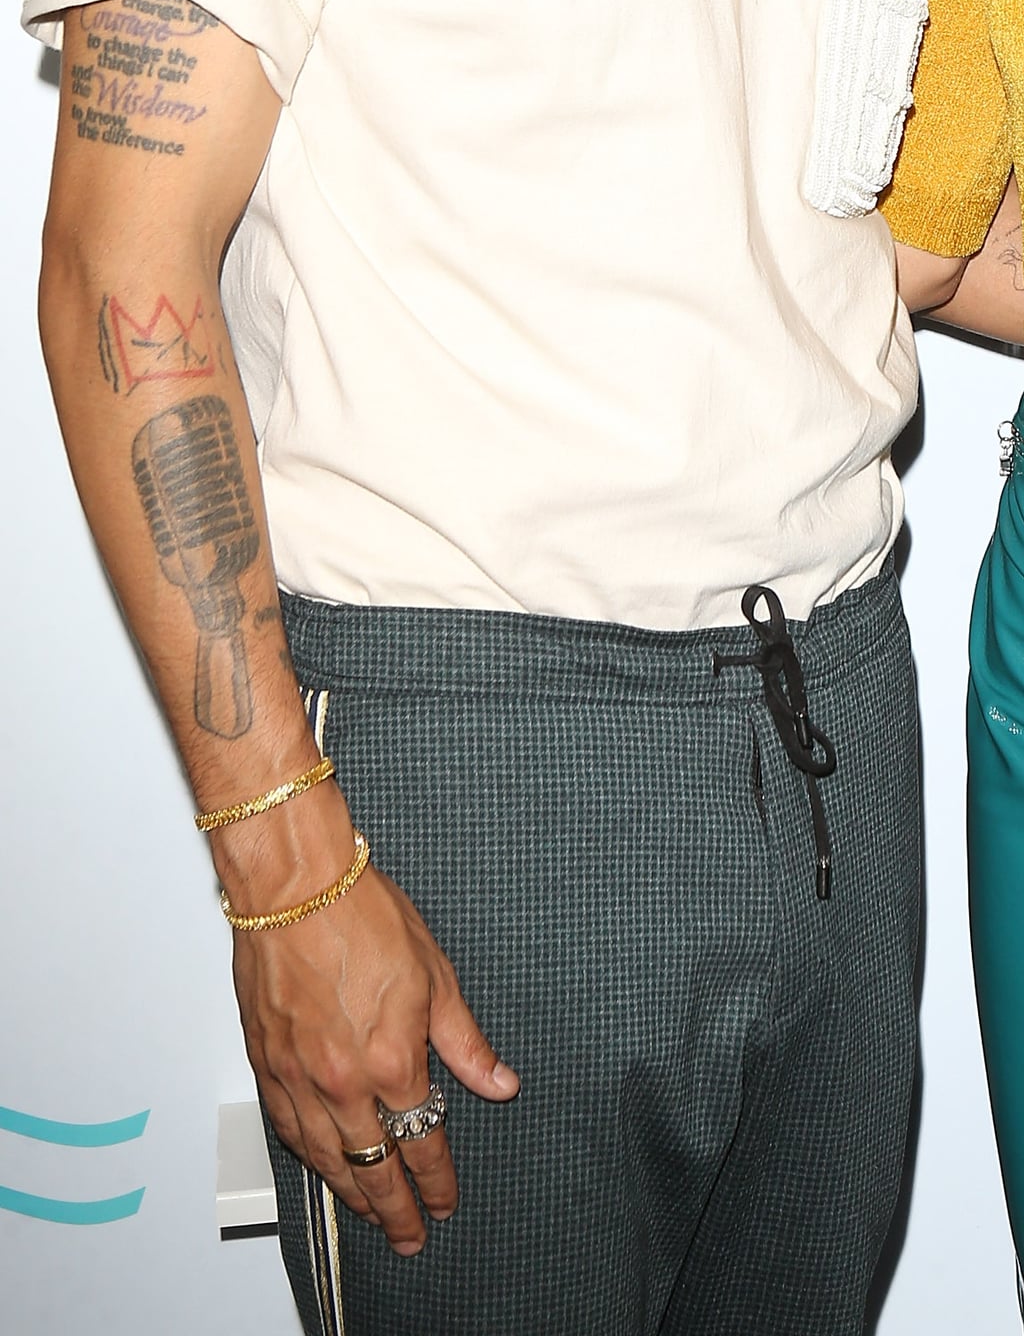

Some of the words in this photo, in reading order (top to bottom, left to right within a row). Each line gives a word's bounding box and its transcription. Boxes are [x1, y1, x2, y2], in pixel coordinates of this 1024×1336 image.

[80, 5, 206, 46] Courage
[87, 33, 101, 50] to
[104, 35, 164, 64] change
[168, 48, 198, 70] the
[98, 51, 143, 77] things
[158, 67, 189, 84] can
[93, 71, 207, 124] Wisdom
[86, 106, 127, 128] know
[77, 122, 99, 141] the
[102, 127, 185, 155] difference
